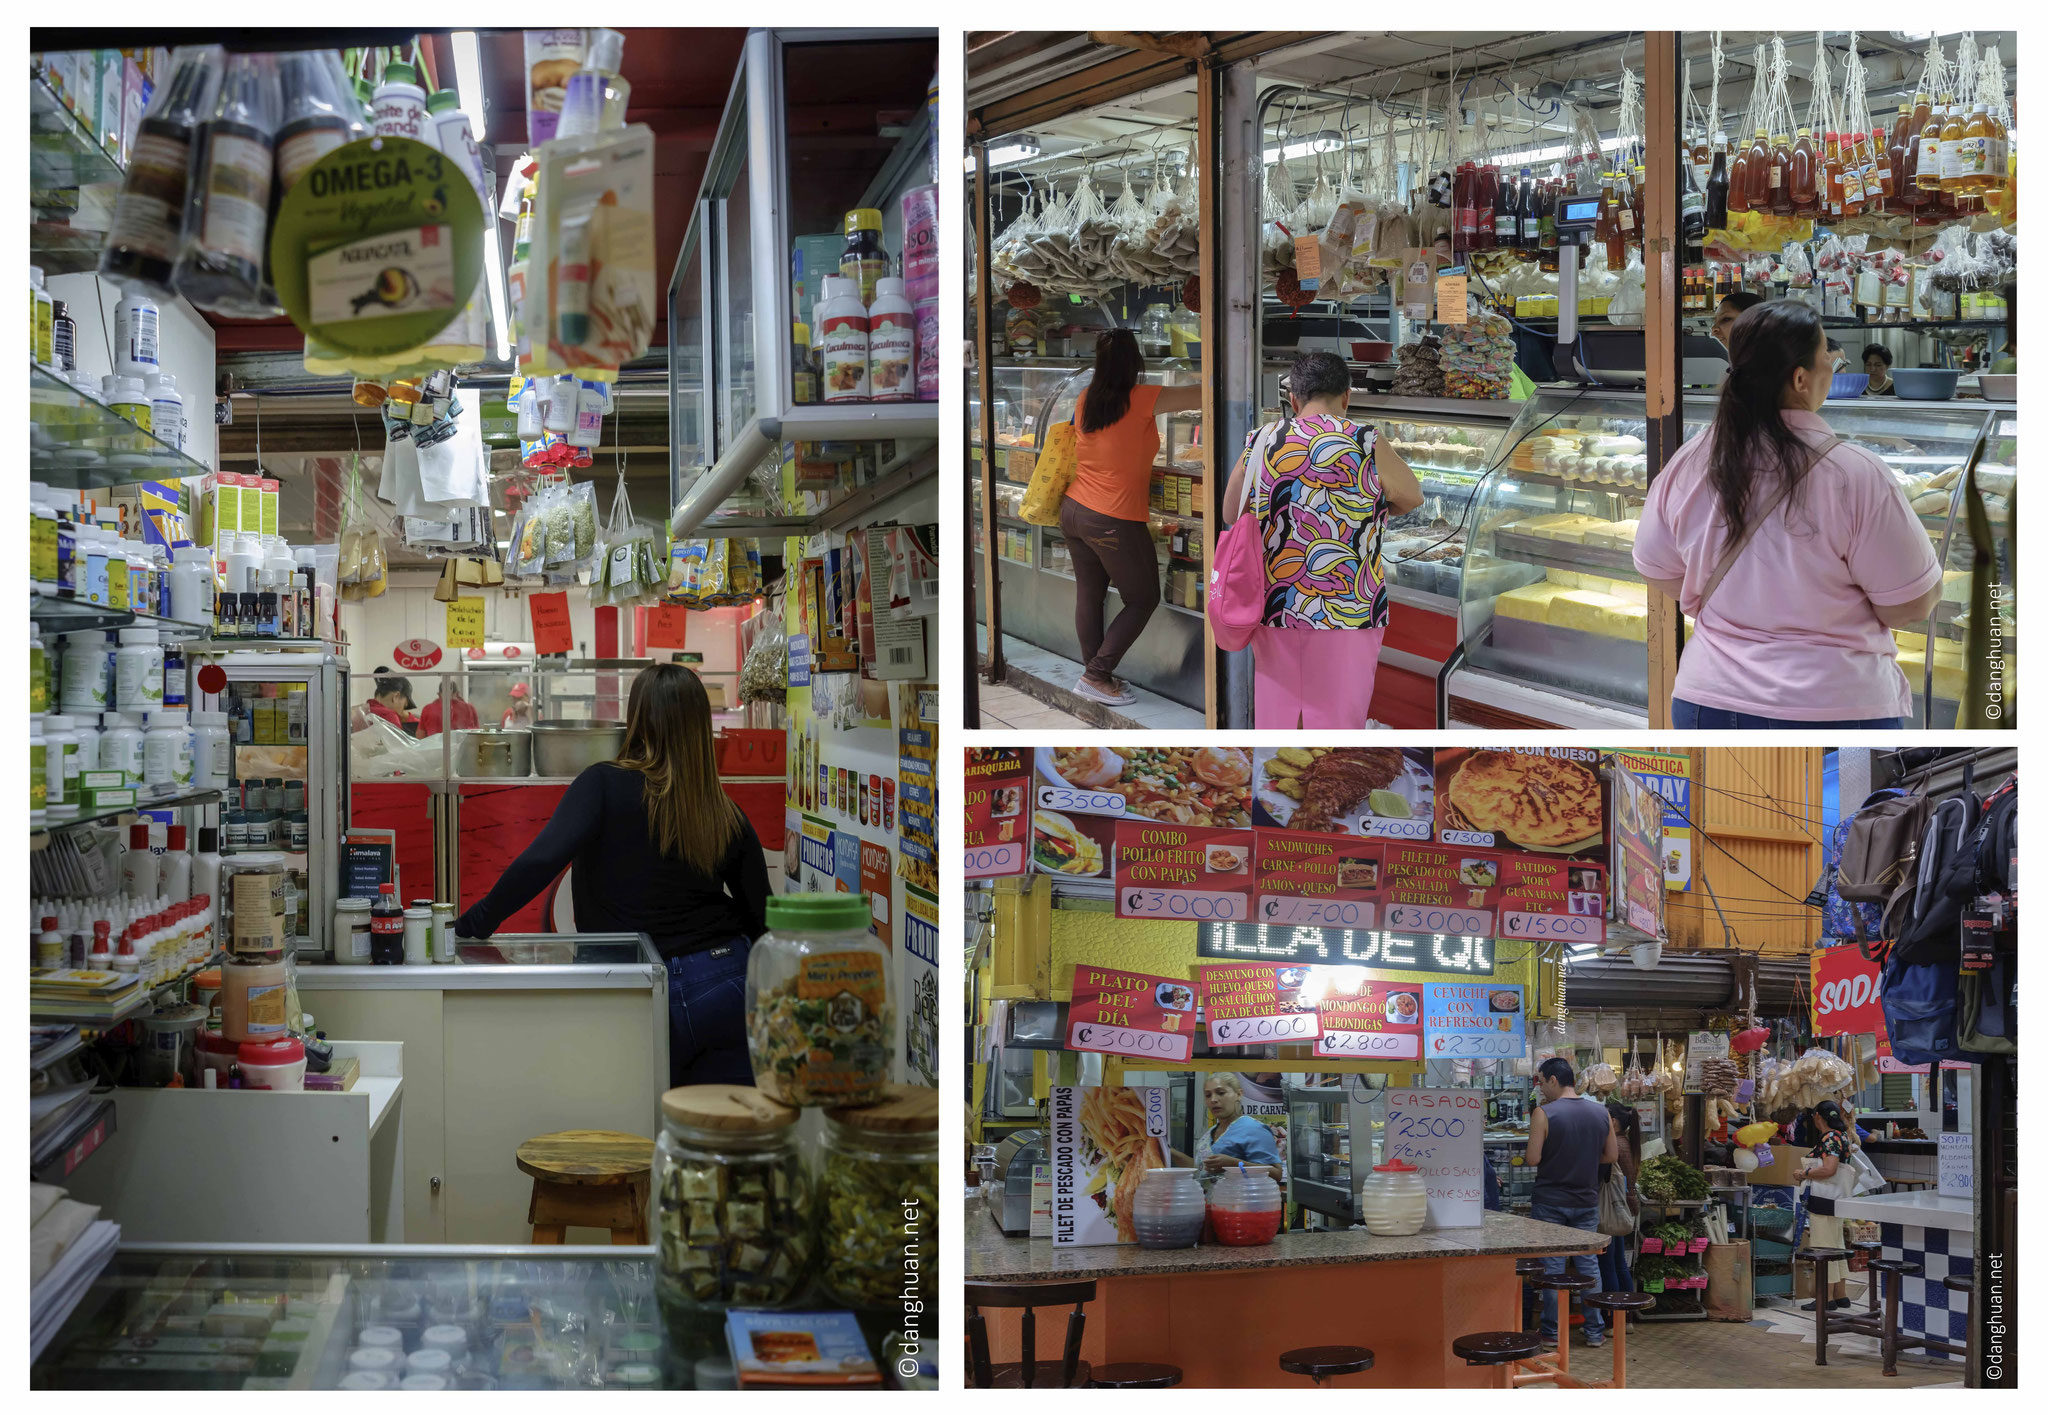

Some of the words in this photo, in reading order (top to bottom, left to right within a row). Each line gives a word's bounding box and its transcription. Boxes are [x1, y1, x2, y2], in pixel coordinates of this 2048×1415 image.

[310, 154, 445, 198] OMEGA-3
[825, 340, 866, 354] Cuculmeca
[401, 657, 435, 669] CAJA
[1515, 747, 1545, 755] CON
[1550, 748, 1596, 762] QUESO
[1141, 829, 1187, 845] COMBO
[1122, 846, 1164, 862] POLLO
[1166, 850, 1205, 865] FRITO
[1268, 840, 1333, 856] SANDWICHES
[1401, 850, 1432, 864] FILET
[1434, 854, 1448, 866] DE
[1262, 858, 1296, 872] CARNE
[1304, 861, 1336, 875] POLLO
[1387, 863, 1435, 878] PESCADO
[1438, 867, 1459, 880] CON
[1515, 862, 1557, 874] BATIDOS
[1130, 866, 1157, 880] CON
[1161, 868, 1197, 883] PAPAS
[1522, 875, 1550, 887] MORA
[1260, 877, 1295, 891] JAMÓN
[1303, 881, 1336, 896] QUESO
[1395, 878, 1449, 892] ENSALADA
[1390, 890, 1396, 902] Y
[1399, 891, 1453, 905] REFRESCO
[1506, 886, 1566, 901] GUANABANA
[1525, 902, 1547, 912] ETC.
[1343, 929, 1416, 964] DE
[1089, 971, 1148, 992] PLATO
[1206, 969, 1254, 981] DESAYUNO
[1255, 968, 1275, 978] CON
[1209, 982, 1242, 993] HUEVO,
[1244, 980, 1274, 993] QUESO
[1360, 985, 1372, 996] DE
[1433, 987, 1488, 999] CEVICHE
[1817, 971, 1884, 1015] SODA
[1098, 992, 1135, 1008] DEL
[1210, 995, 1217, 1006] O
[1219, 991, 1276, 1006] SALCHICHÓN
[1213, 1008, 1237, 1019] TAZA
[1239, 1007, 1253, 1018] DE
[1255, 1003, 1277, 1016] CAFÉ
[1320, 1000, 1376, 1013] MONDONGO
[1378, 999, 1385, 1014] Ó
[1448, 1001, 1473, 1013] CON
[1097, 1010, 1130, 1026] DÍA
[1323, 1017, 1383, 1031] ALBONDIGAS
[1429, 1016, 1493, 1028] REFRESCO
[1056, 1087, 1073, 1119] PAPAS
[1391, 1093, 1481, 1109] CASADO
[1247, 1105, 1257, 1114] DE
[1057, 1121, 1074, 1143] CON
[1941, 1136, 1968, 1144] SOPA
[1057, 1146, 1074, 1195] PESCADO
[1418, 1166, 1450, 1178] OLLO
[1058, 1195, 1074, 1208] DE
[1058, 1210, 1074, 1243] FILET
